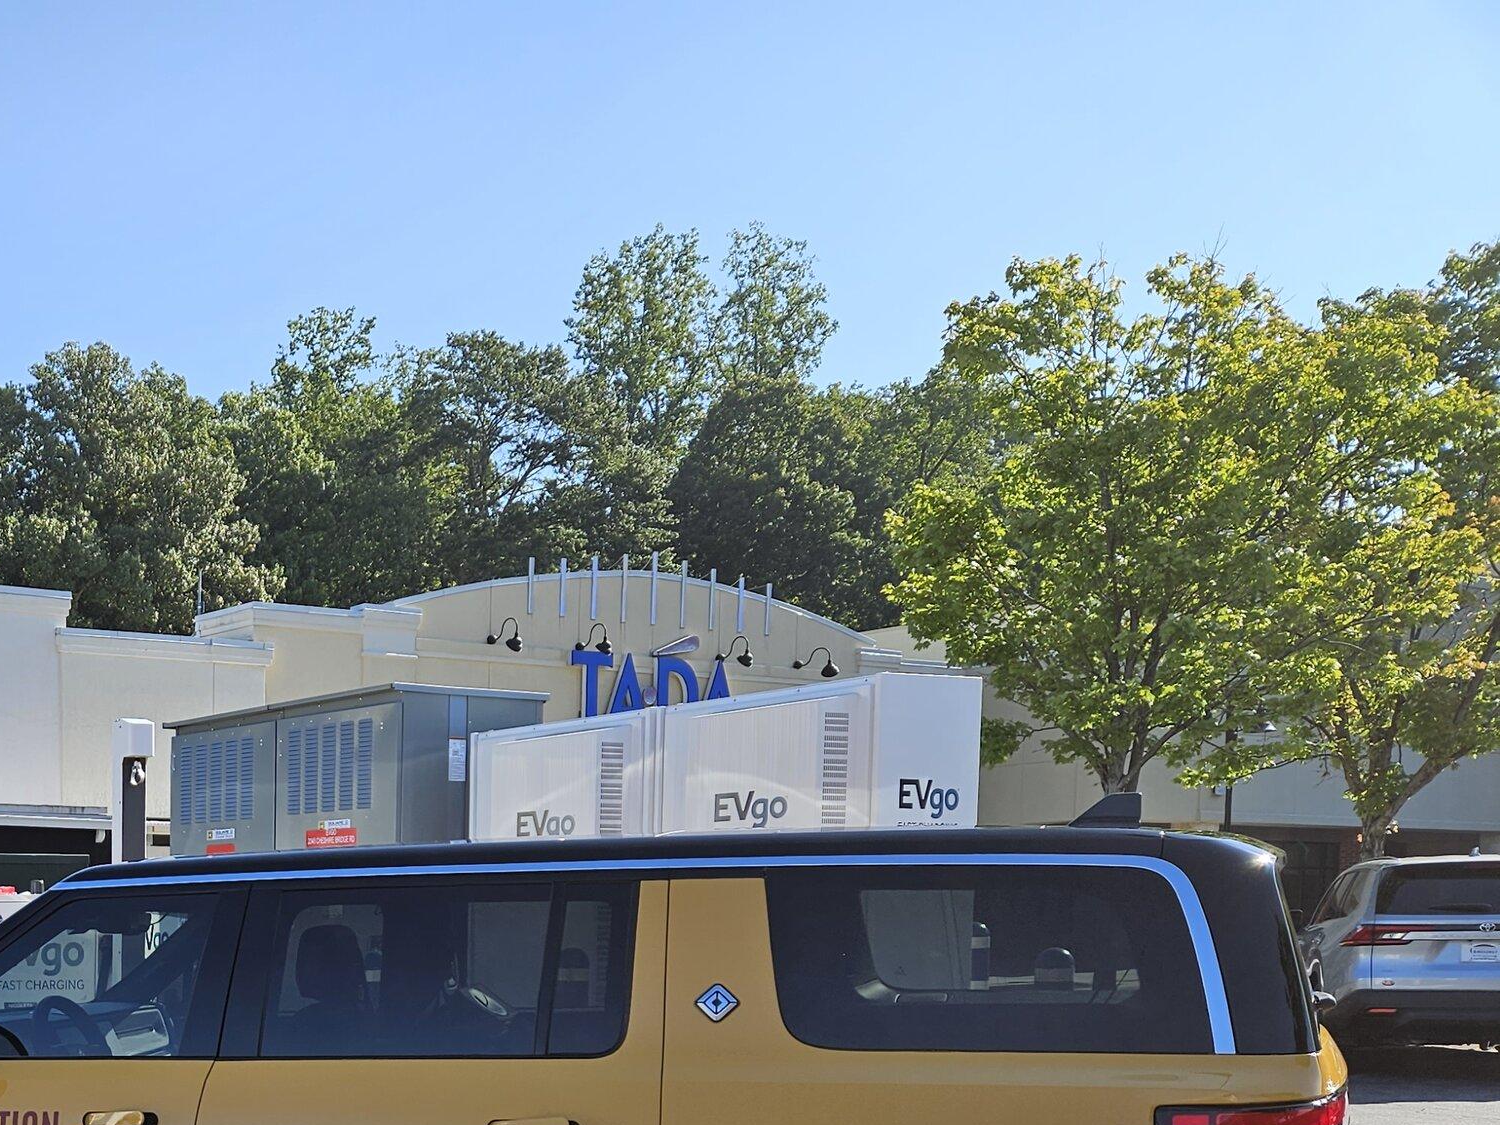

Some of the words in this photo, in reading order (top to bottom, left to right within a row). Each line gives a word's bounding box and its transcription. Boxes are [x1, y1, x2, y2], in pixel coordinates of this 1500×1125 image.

[714, 791, 788, 828] EVgo
[899, 778, 960, 818] EVgo
[25, 979, 85, 990] CHARGING
